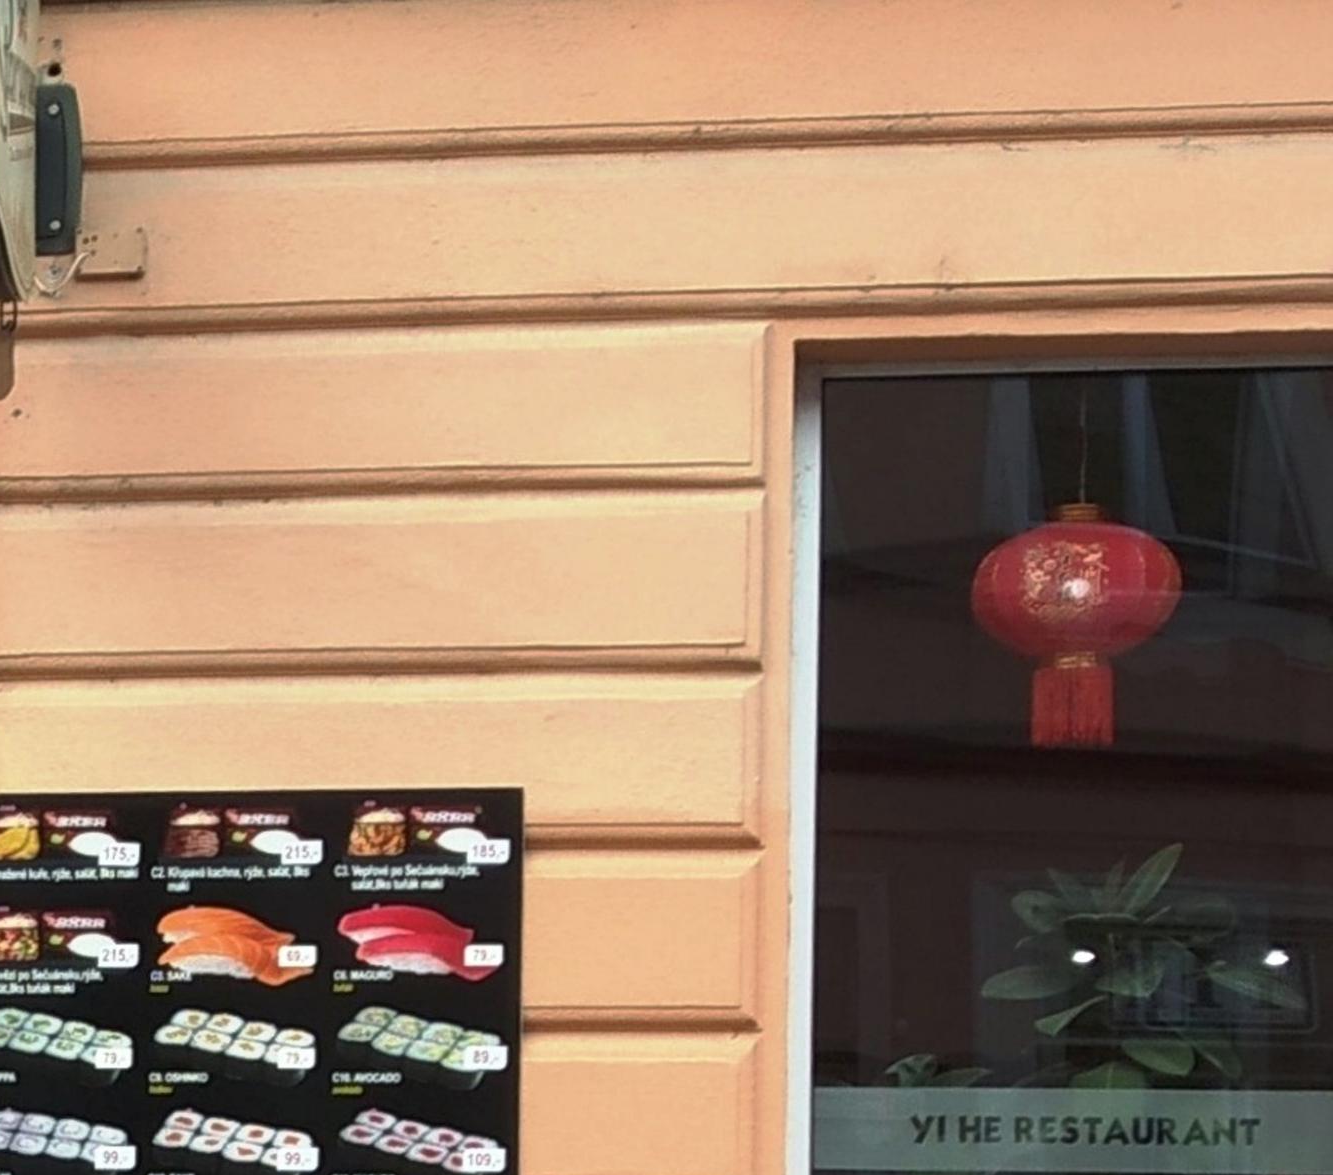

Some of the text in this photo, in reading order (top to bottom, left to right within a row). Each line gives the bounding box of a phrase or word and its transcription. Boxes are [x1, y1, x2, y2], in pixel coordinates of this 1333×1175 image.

[354, 1072, 402, 1083] AVOCADO
[911, 1115, 1261, 1146] YI HE RESTAURANT
